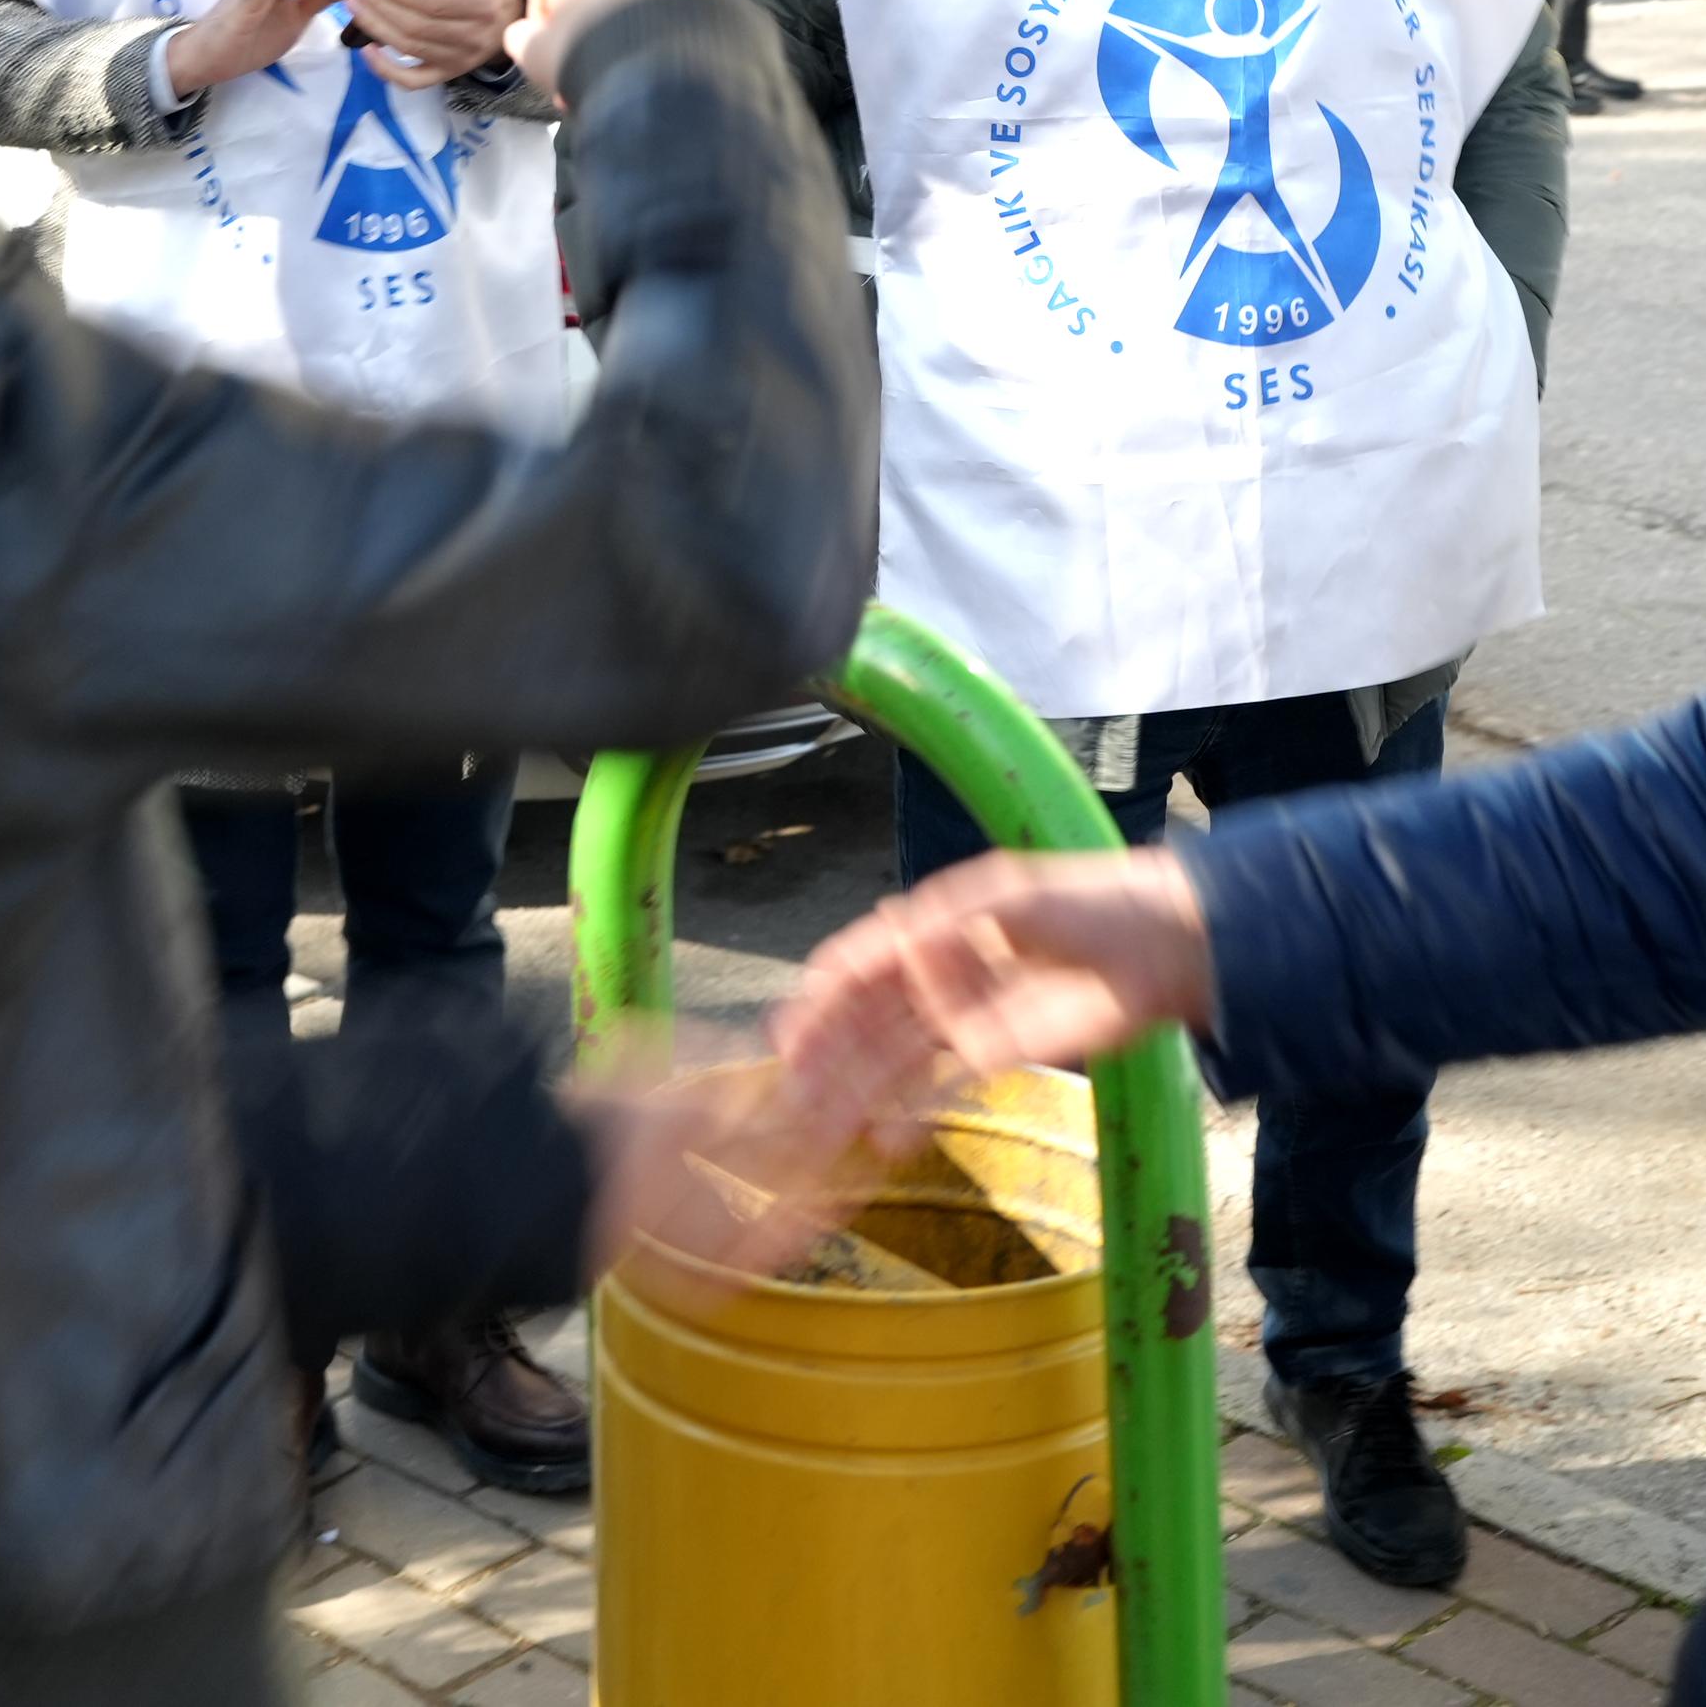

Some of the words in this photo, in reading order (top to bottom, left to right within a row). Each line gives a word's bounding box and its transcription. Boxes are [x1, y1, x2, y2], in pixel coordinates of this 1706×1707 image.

[989, 123, 1022, 178] VE
[1397, 62, 1437, 295] SENDİKASI
[344, 207, 430, 244] 1996
[994, 190, 1096, 336] SAĞLIK
[357, 270, 437, 311] SES
[1213, 296, 1310, 336] 1996
[1223, 363, 1314, 410] SES
